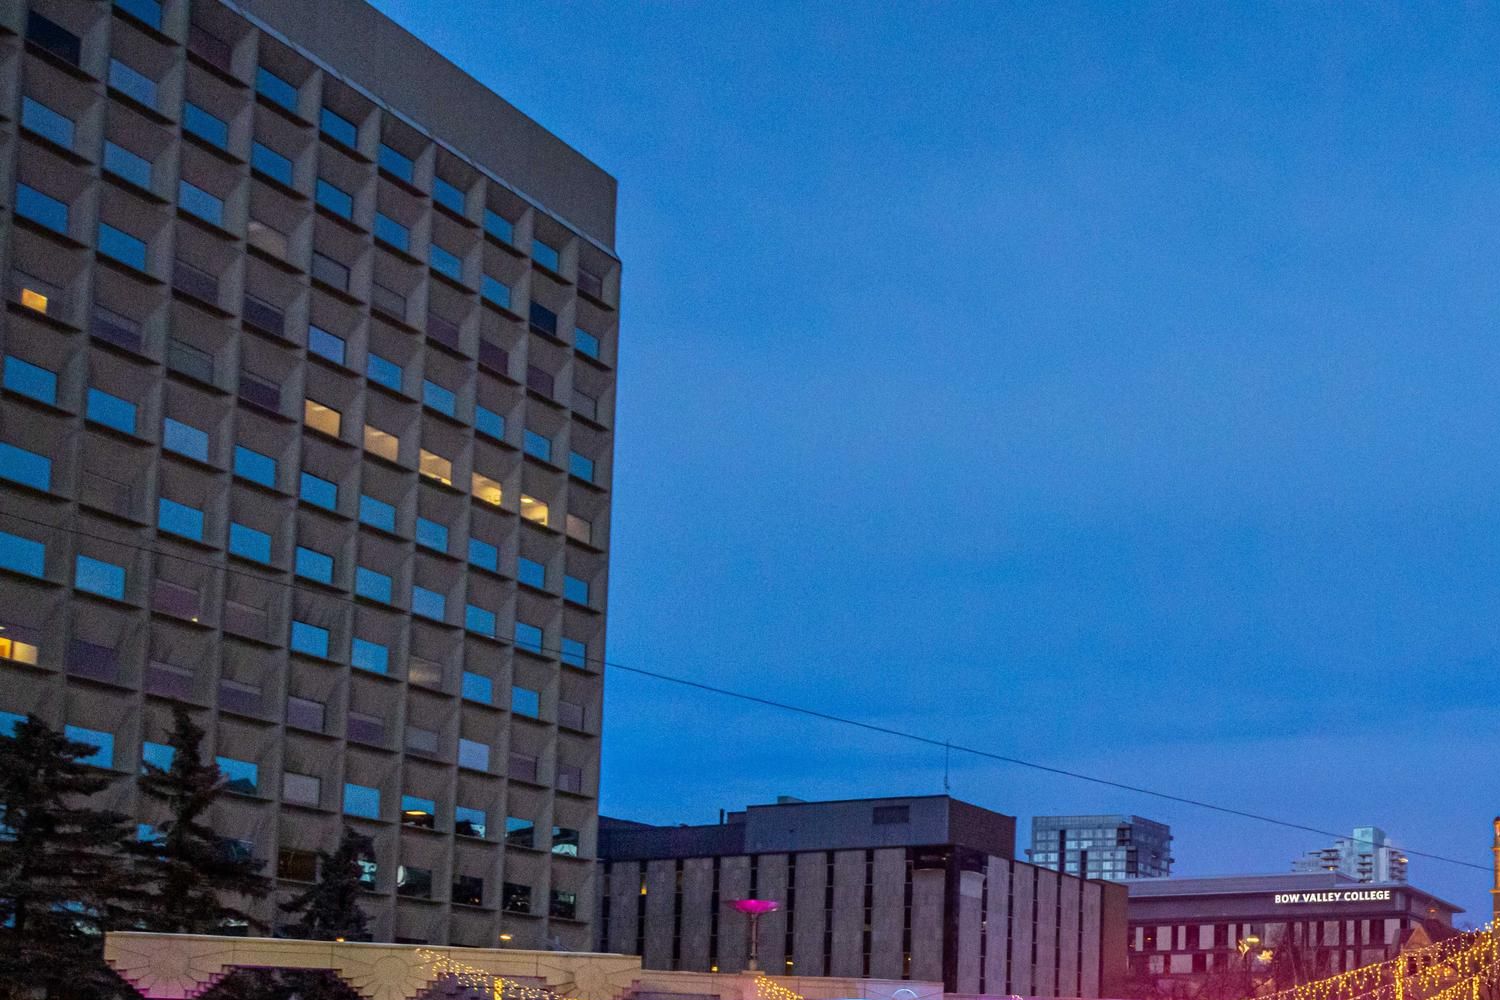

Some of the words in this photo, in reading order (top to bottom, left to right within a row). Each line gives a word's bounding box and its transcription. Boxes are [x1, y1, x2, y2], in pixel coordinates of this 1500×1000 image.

[1274, 894, 1300, 904] BOW
[1302, 892, 1341, 902] VALLEY
[1344, 890, 1391, 901] COLLEGE
